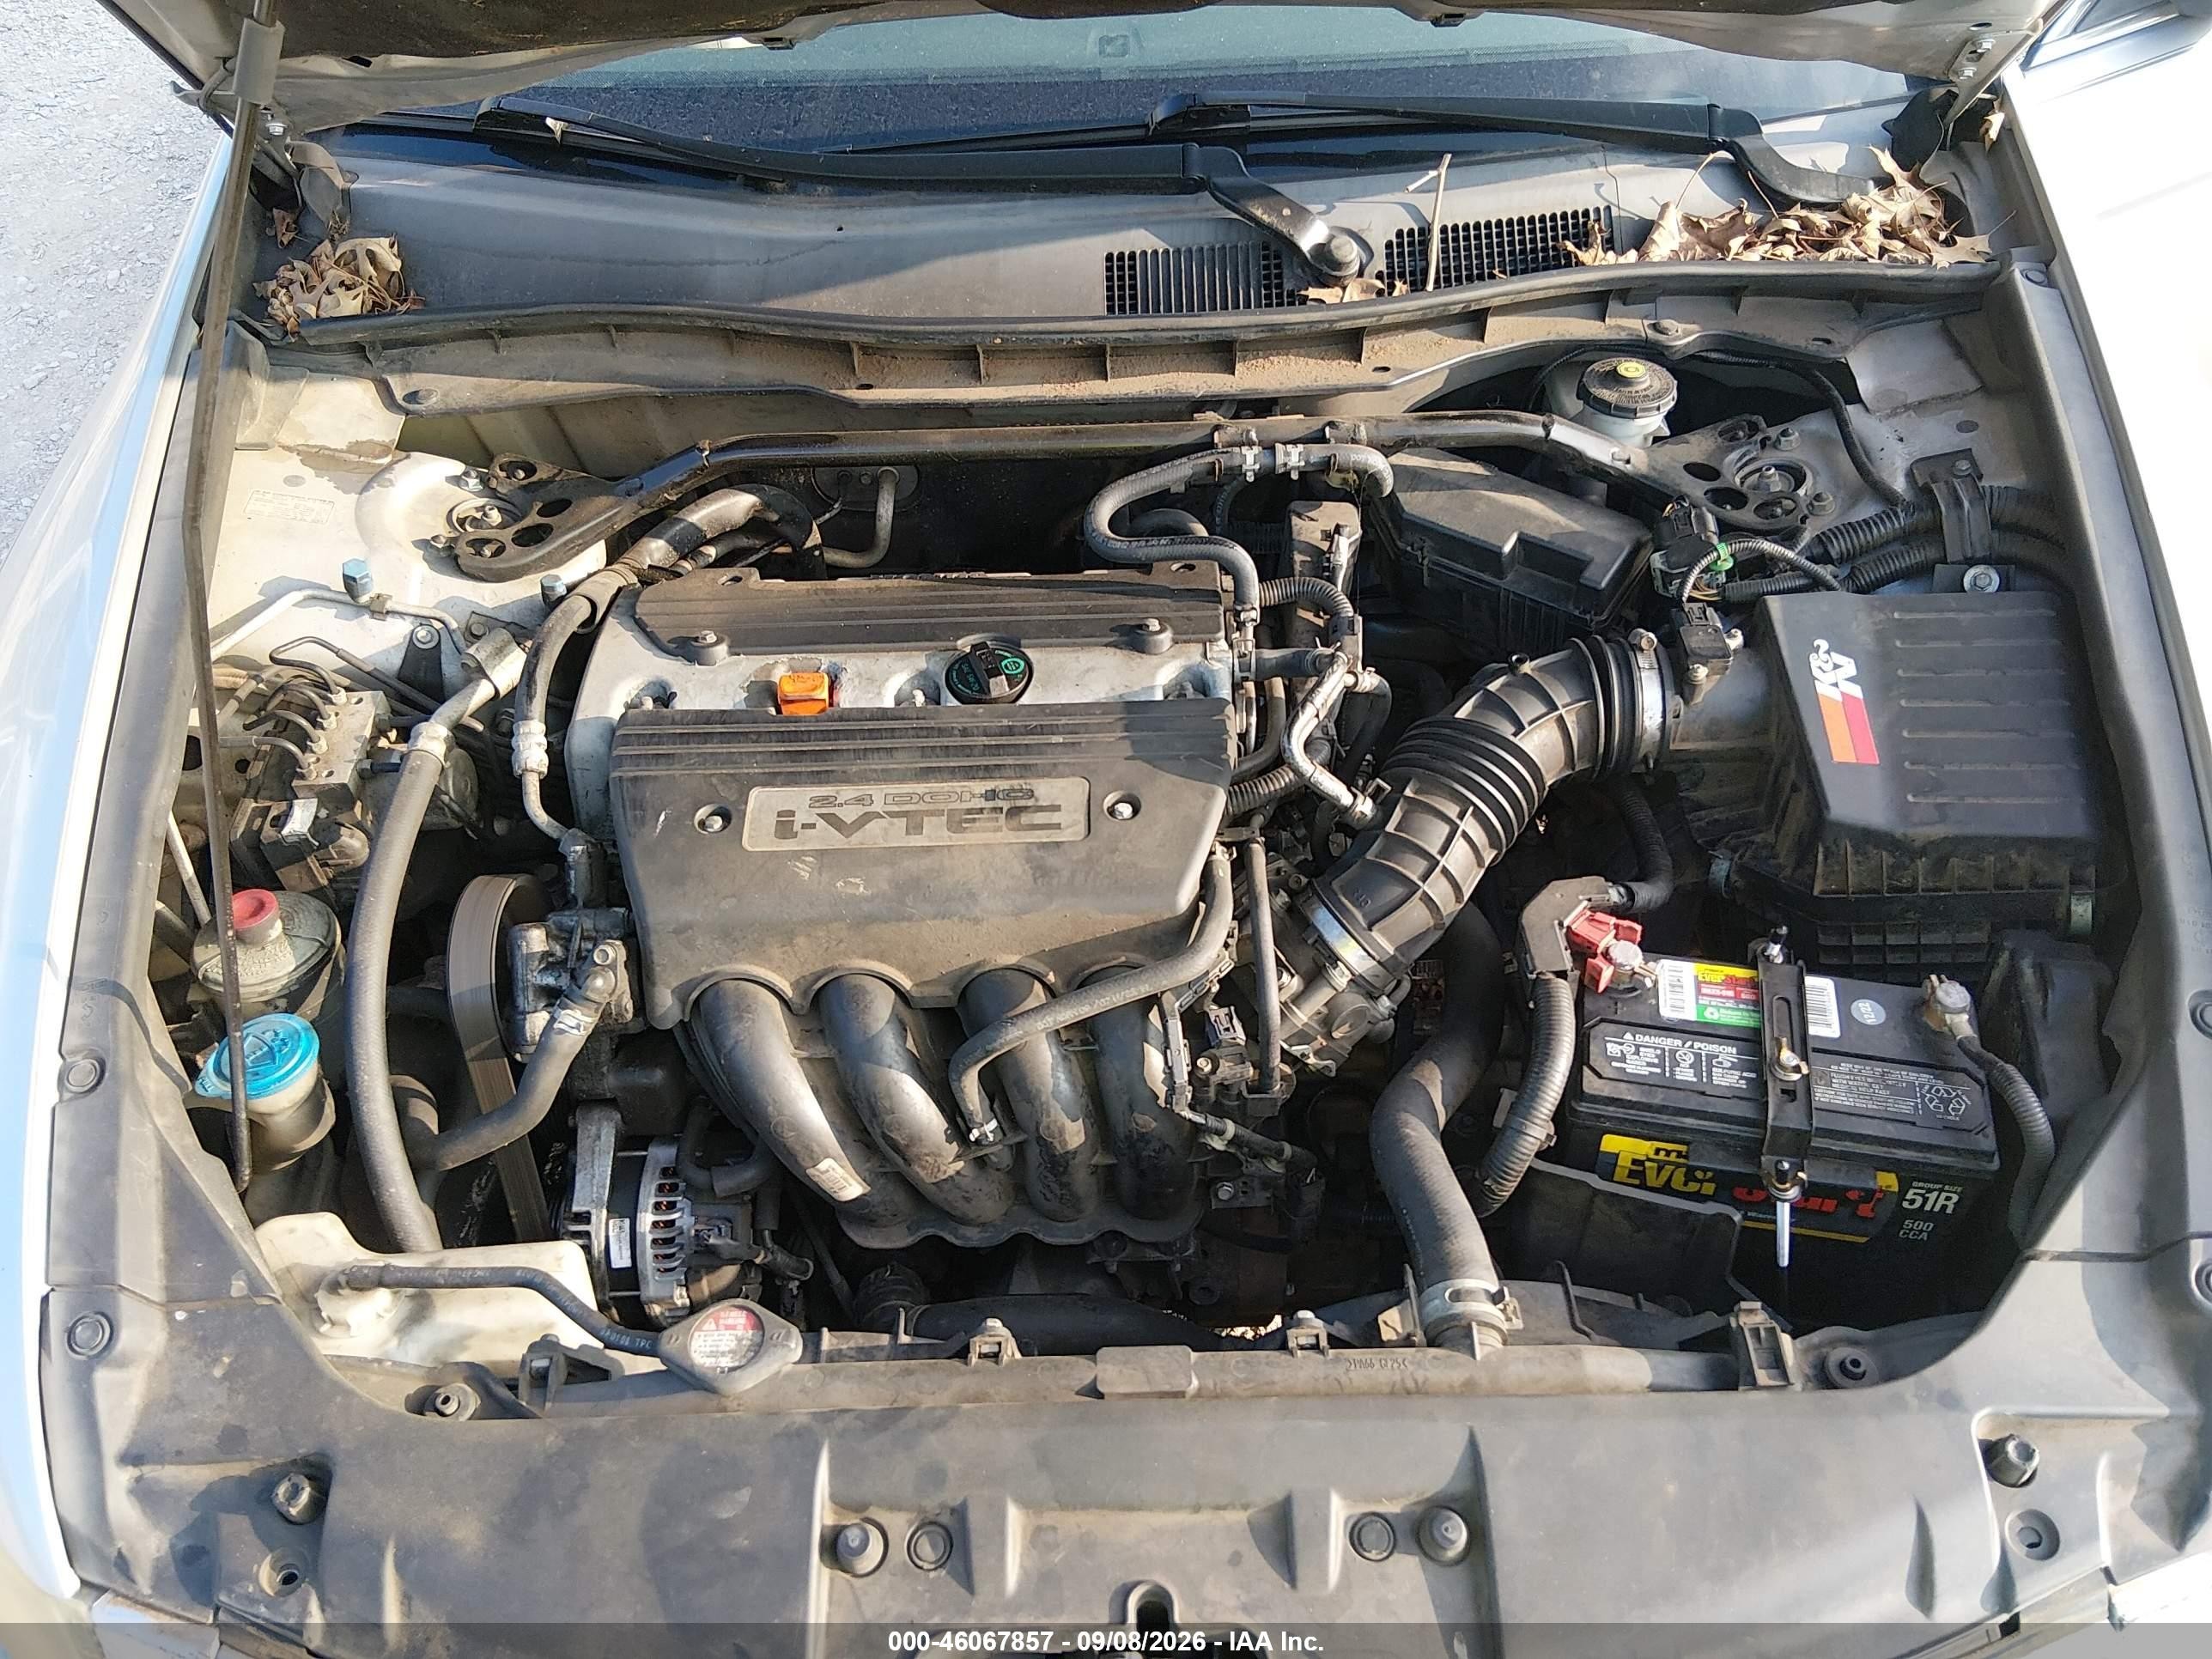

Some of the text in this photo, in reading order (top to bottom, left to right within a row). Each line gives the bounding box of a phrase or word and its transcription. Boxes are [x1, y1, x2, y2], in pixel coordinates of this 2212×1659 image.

[808, 787, 1036, 809] 2.4 DOHC
[773, 804, 1062, 841] i-VTEC
[1863, 1001, 1880, 1025] 12/22
[1634, 1033, 1683, 1048] DANGER
[1693, 1041, 1738, 1054] POISON
[1911, 1181, 1965, 1193] GROUP SIZE
[1901, 1188, 1960, 1215] 51R
[1899, 1229, 1929, 1242] CCA
[1902, 1219, 1935, 1231] 500
